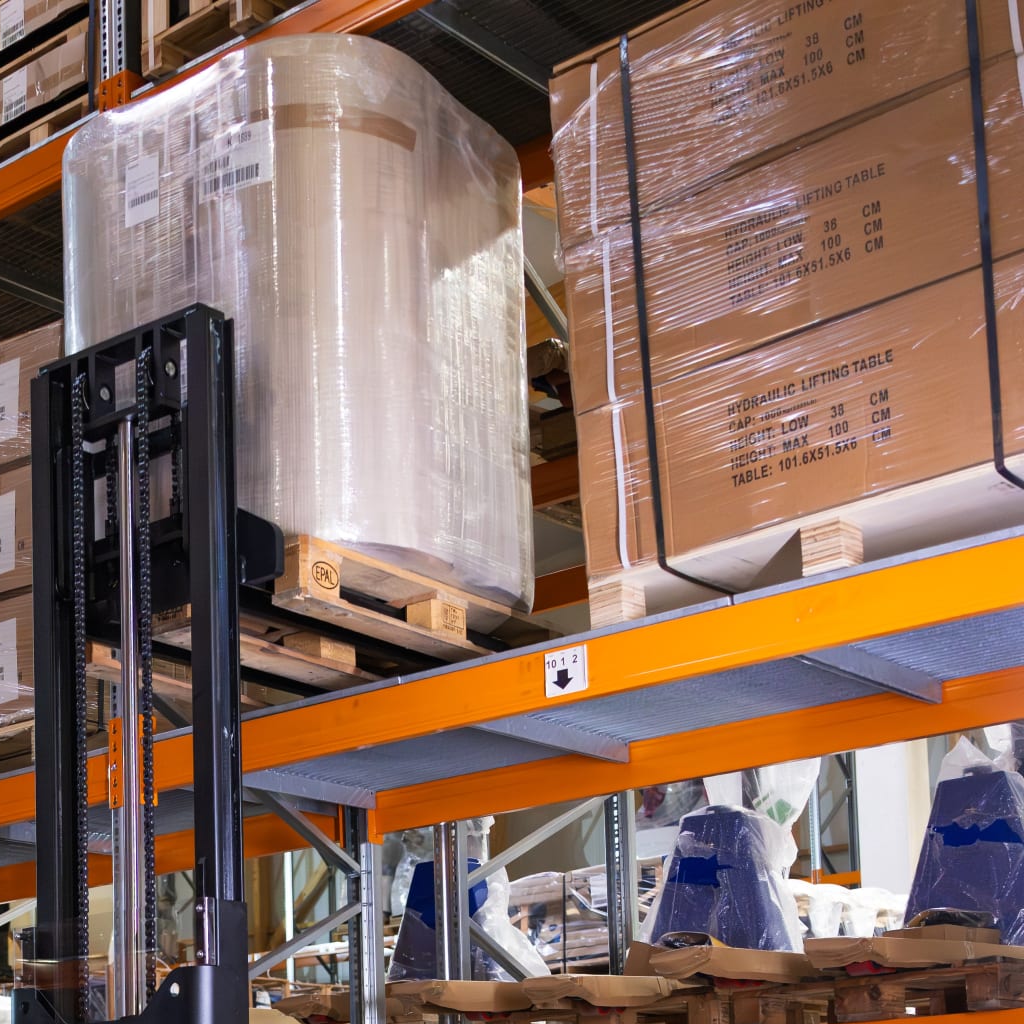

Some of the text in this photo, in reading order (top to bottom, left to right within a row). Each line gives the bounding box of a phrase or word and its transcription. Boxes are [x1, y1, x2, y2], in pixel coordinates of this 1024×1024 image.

[805, 32, 819, 47] 38
[844, 13, 863, 31] CM
[760, 30, 864, 86] MAX 100 CM
[846, 48, 865, 65] CM
[795, 181, 842, 209] LIFTING
[845, 163, 886, 189] TABLE
[824, 218, 837, 233] 38
[862, 200, 881, 218] CM
[821, 234, 841, 252] 100
[864, 218, 883, 236] CM
[865, 235, 884, 253] CM
[727, 384, 796, 416] HYDRAULIC
[801, 364, 850, 392] LIFTING
[852, 349, 894, 374] TABLE
[728, 416, 756, 434] CAP:
[781, 415, 809, 435] LOW
[830, 403, 845, 419] 38
[869, 388, 889, 406] CM
[783, 434, 809, 454] MAX
[828, 420, 849, 438] 100
[871, 407, 891, 424] CM
[731, 427, 891, 487] TABLE: 101.6X51.5X6 CM
[315, 565, 334, 586] EPAL
[547, 659, 557, 669] 10
[573, 654, 578, 663] 2
